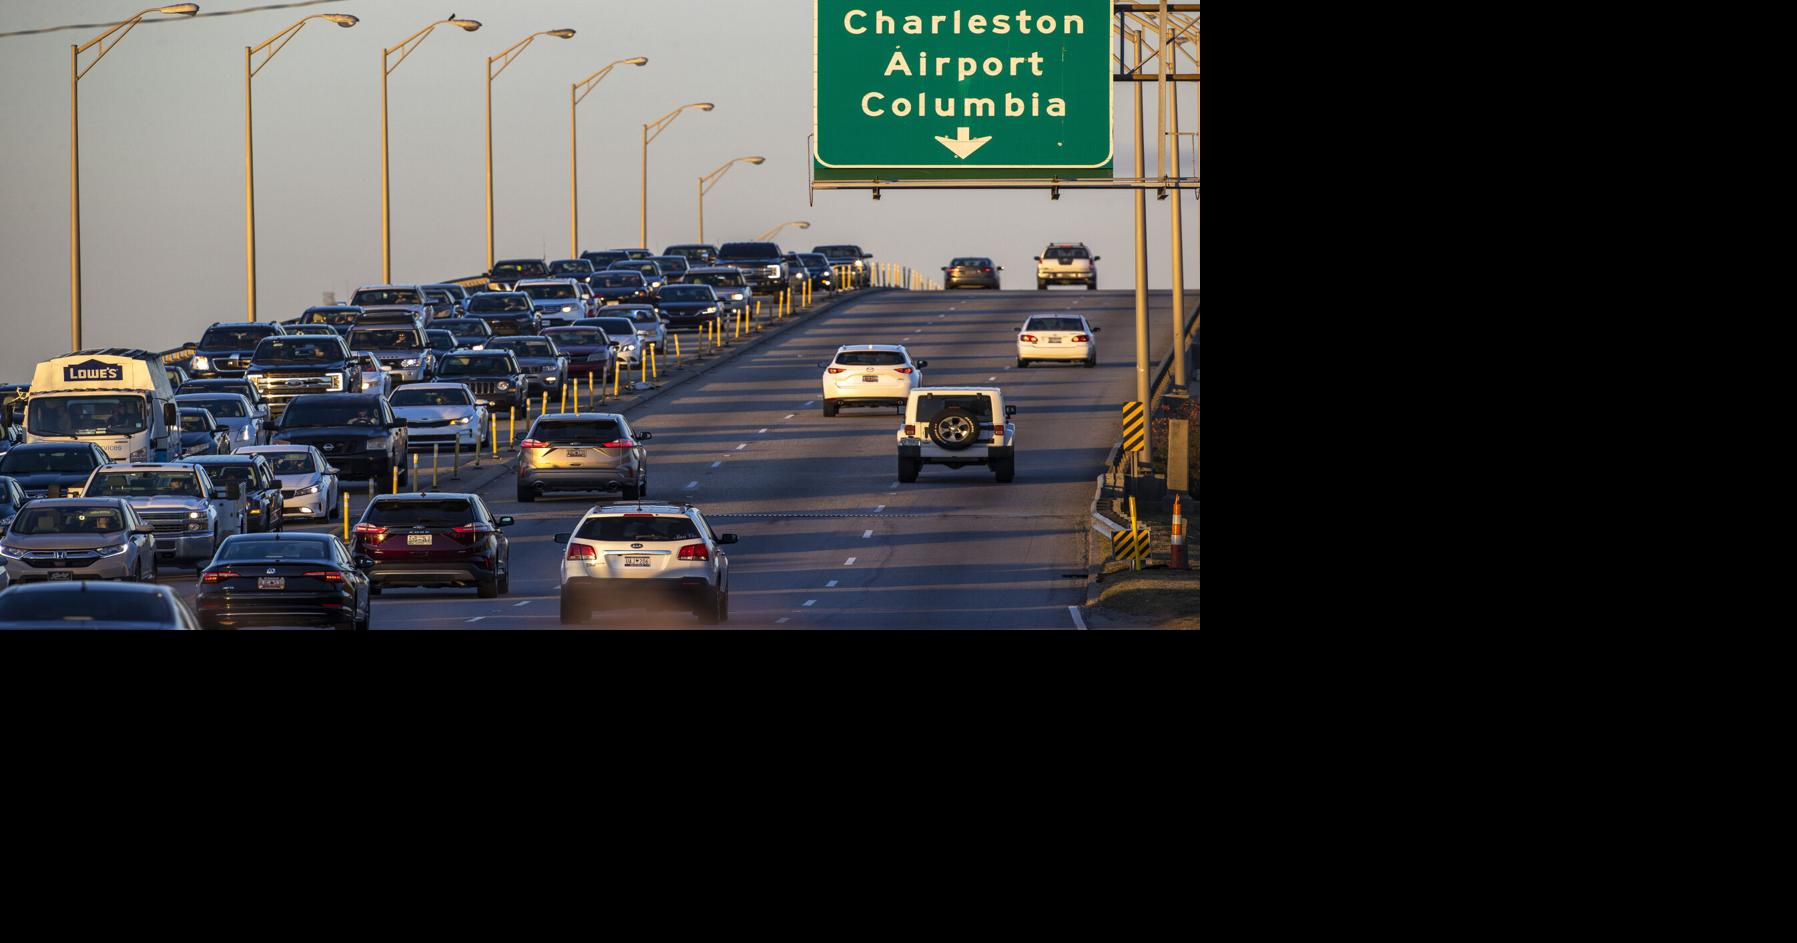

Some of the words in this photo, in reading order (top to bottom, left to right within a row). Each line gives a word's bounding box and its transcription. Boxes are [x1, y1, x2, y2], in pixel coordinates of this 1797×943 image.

[843, 9, 1085, 35] Charleston
[883, 51, 1044, 82] Airport
[861, 91, 1067, 117] Columbia
[69, 367, 117, 379] LOWE'S
